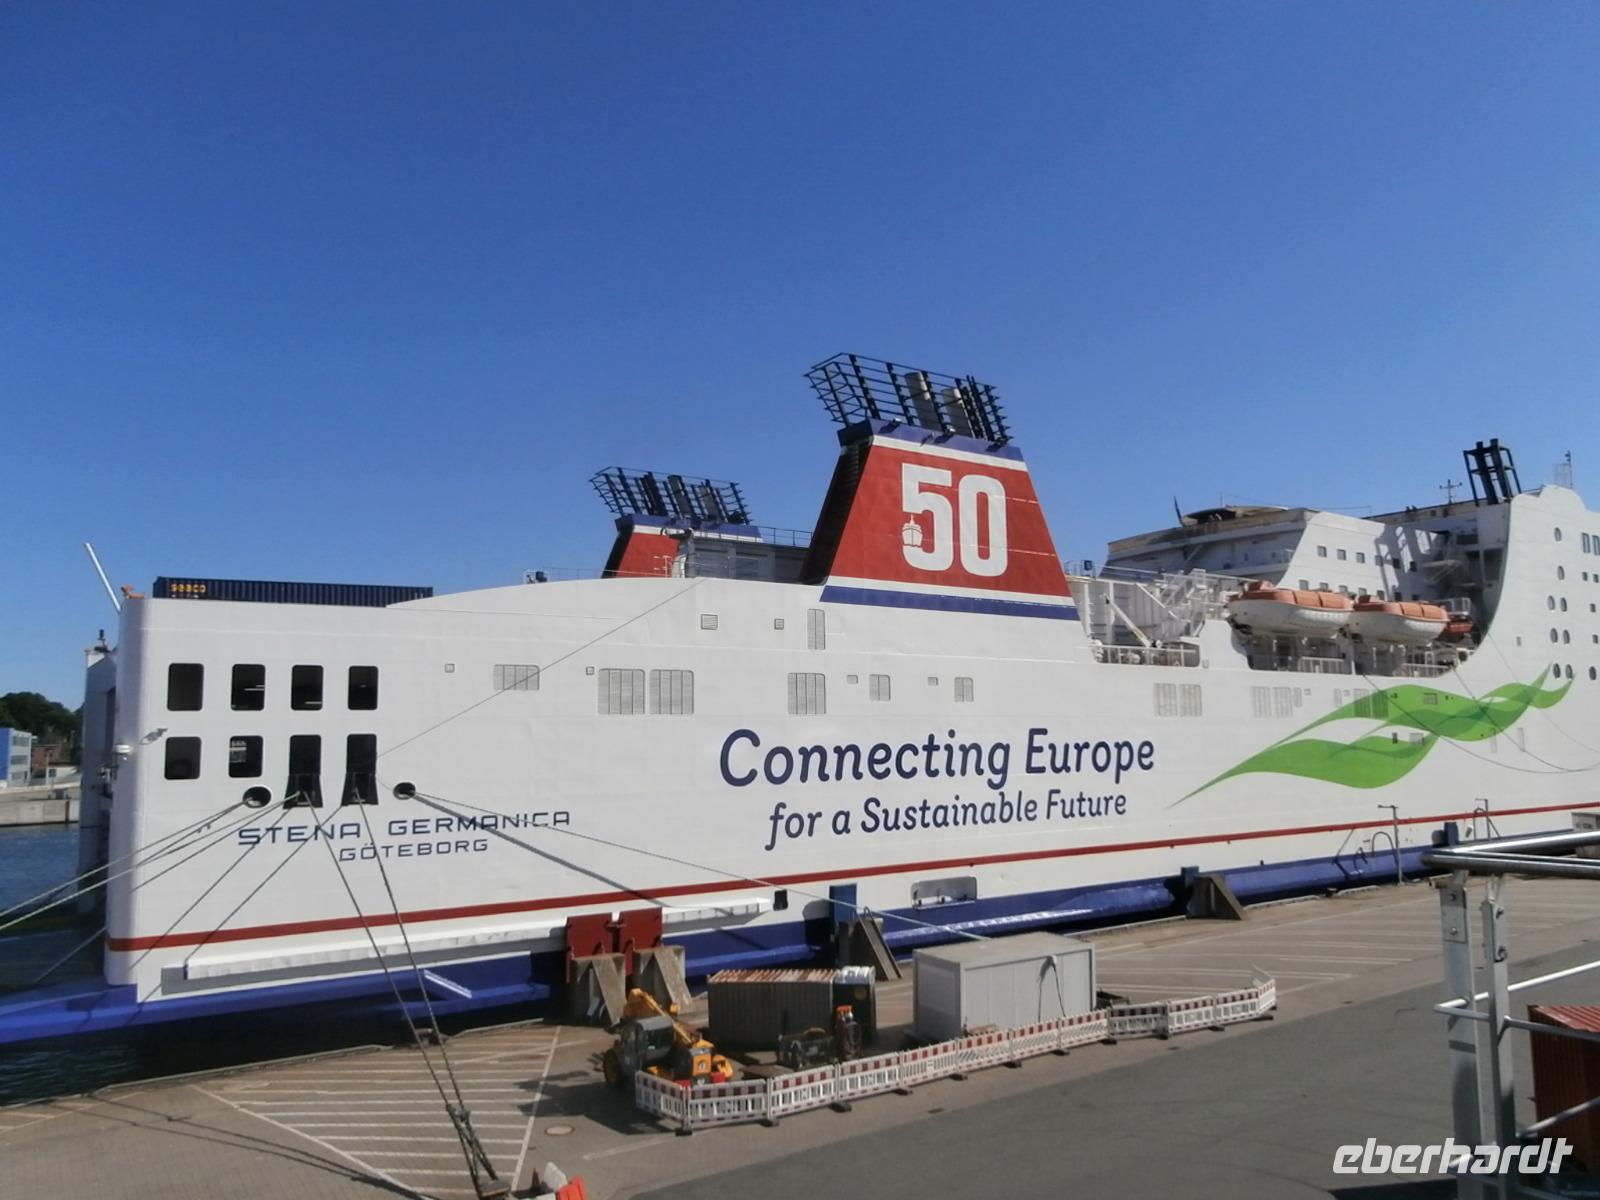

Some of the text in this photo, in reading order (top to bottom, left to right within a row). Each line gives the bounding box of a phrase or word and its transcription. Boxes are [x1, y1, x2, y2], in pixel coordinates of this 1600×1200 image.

[901, 461, 1008, 577] 50
[719, 727, 1155, 791] Connecting Europe
[238, 810, 571, 846] STENA GERMANICA
[338, 838, 489, 862] GÖTEBORG
[764, 788, 1128, 852] for a Sustainable Future
